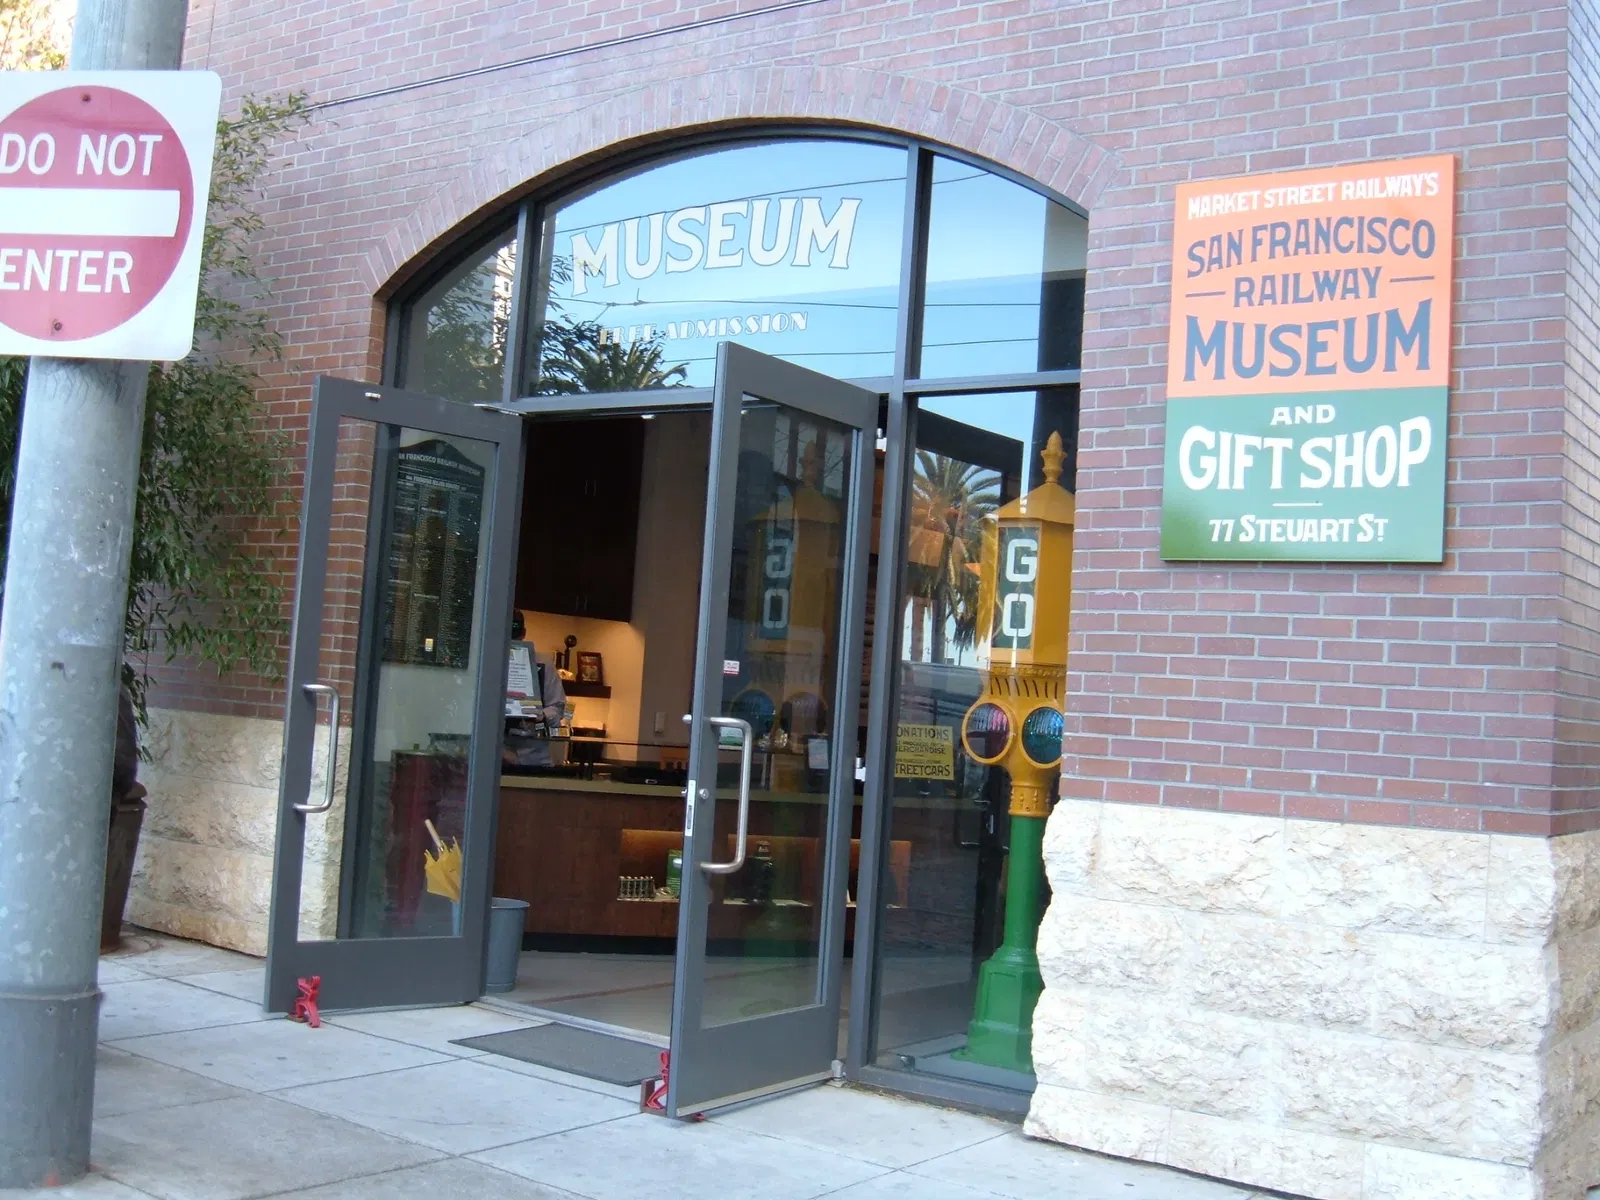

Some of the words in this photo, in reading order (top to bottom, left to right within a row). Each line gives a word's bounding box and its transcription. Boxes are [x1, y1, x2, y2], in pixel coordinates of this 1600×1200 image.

[1, 132, 56, 175] DO
[76, 134, 163, 176] NOT
[1187, 191, 1261, 220] MARKET
[1263, 182, 1338, 208] STREET
[570, 197, 863, 297] MUSEUM
[1187, 229, 1244, 278] SAN
[1250, 216, 1436, 263] FRANCISCO
[0, 248, 134, 293] ENTER
[1233, 266, 1382, 307] RAILWAY
[663, 311, 808, 341] ADMISSION
[1183, 298, 1433, 381] MUSEUM
[1270, 404, 1336, 426] AND
[1179, 425, 1293, 490] GIFT
[1300, 416, 1432, 488] SHOP
[1208, 519, 1236, 542] 77
[1239, 514, 1355, 542] STEUART
[1002, 538, 1038, 637] GO
[896, 726, 949, 741] ONATIONS
[896, 745, 946, 755] ERCHANDISE
[896, 763, 951, 777] TREETCARS
